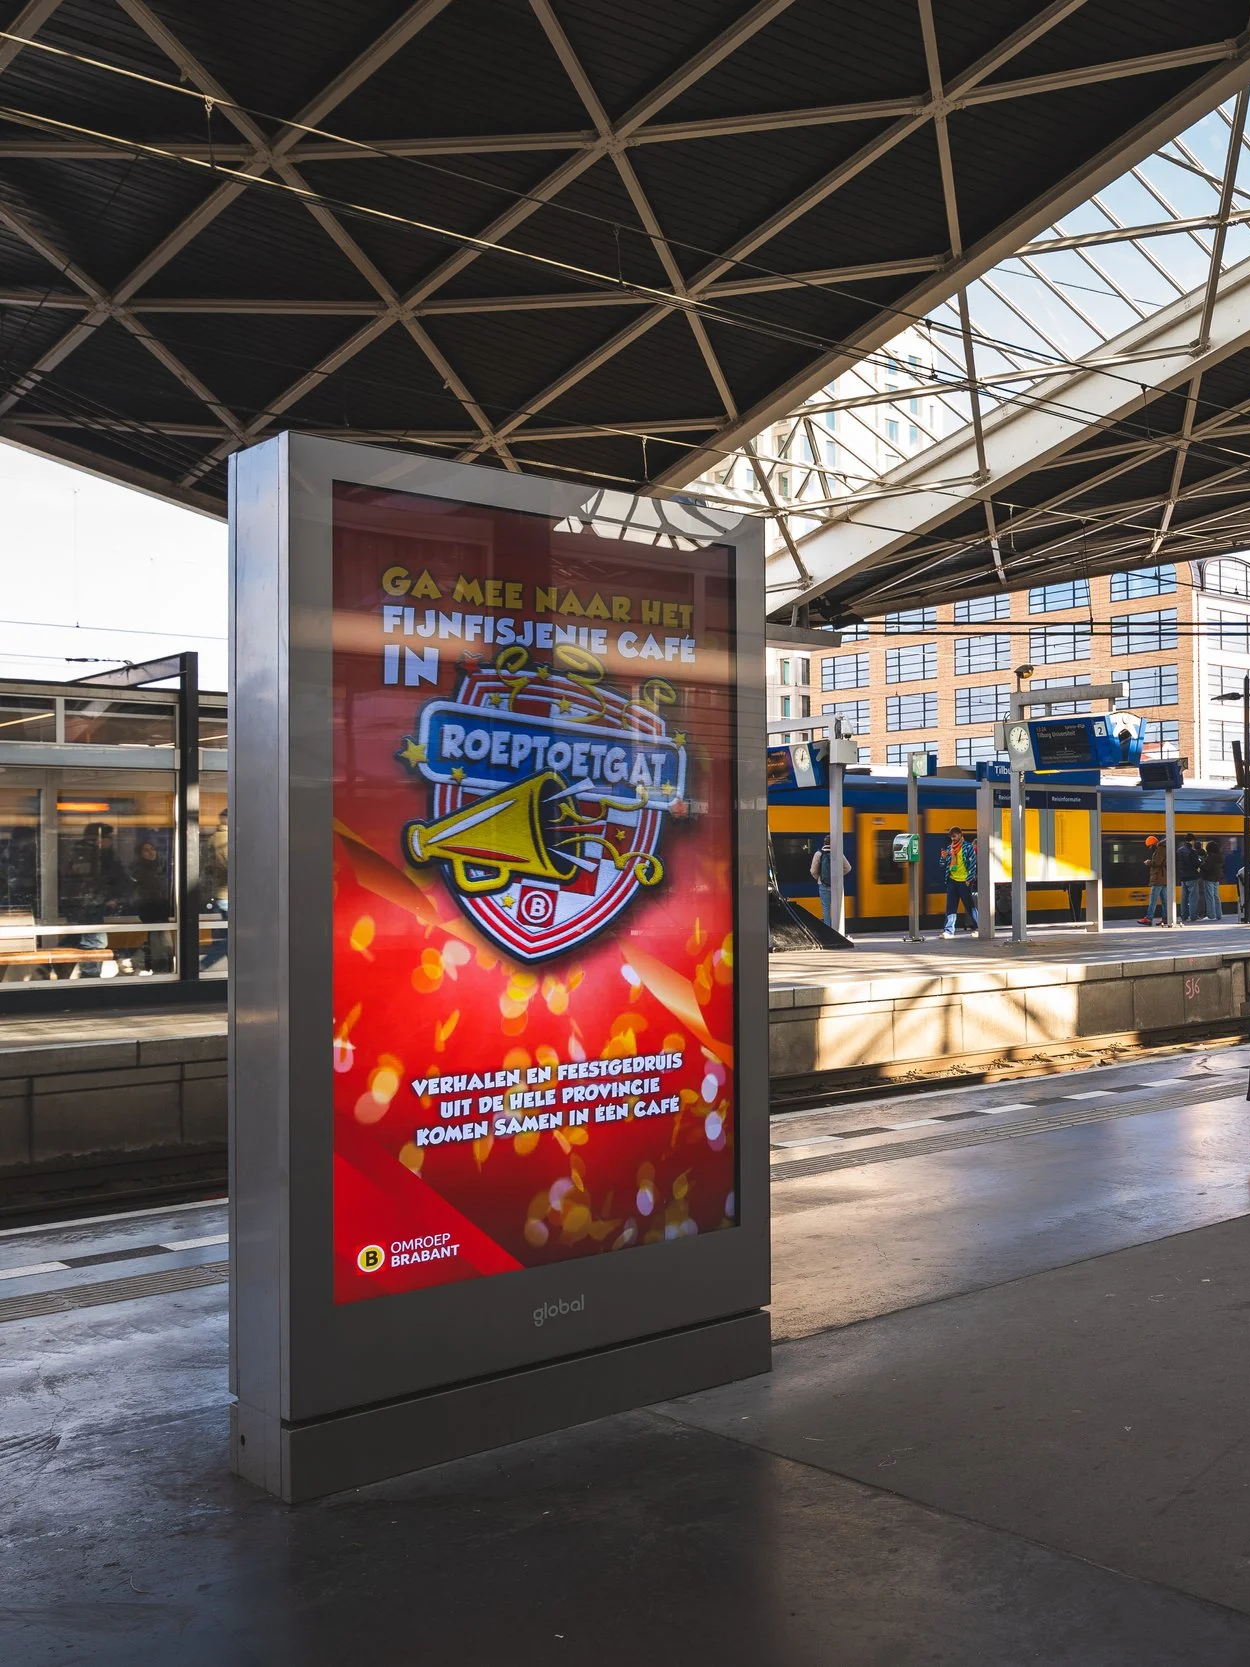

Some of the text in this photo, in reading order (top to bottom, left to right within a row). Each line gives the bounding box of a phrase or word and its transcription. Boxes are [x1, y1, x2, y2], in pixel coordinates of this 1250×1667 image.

[382, 566, 694, 630] GA MEE NAAR HET
[383, 605, 697, 664] FIJNFISJENIE CAFÉ
[383, 644, 440, 687] IN
[1097, 727, 1103, 735] 2
[441, 724, 667, 787] ROEPTOETGAT
[412, 1053, 683, 1097] VERHALEN EN FEESTGEDRUIS
[440, 1077, 660, 1119] UIT DE HELE PROVINCIE
[416, 1096, 680, 1147] KOMEN SAMEN IN ÉÉN CAFÉ
[390, 1233, 451, 1254] OMROEP
[391, 1244, 460, 1268] BRABANT
[533, 1294, 585, 1327] global
